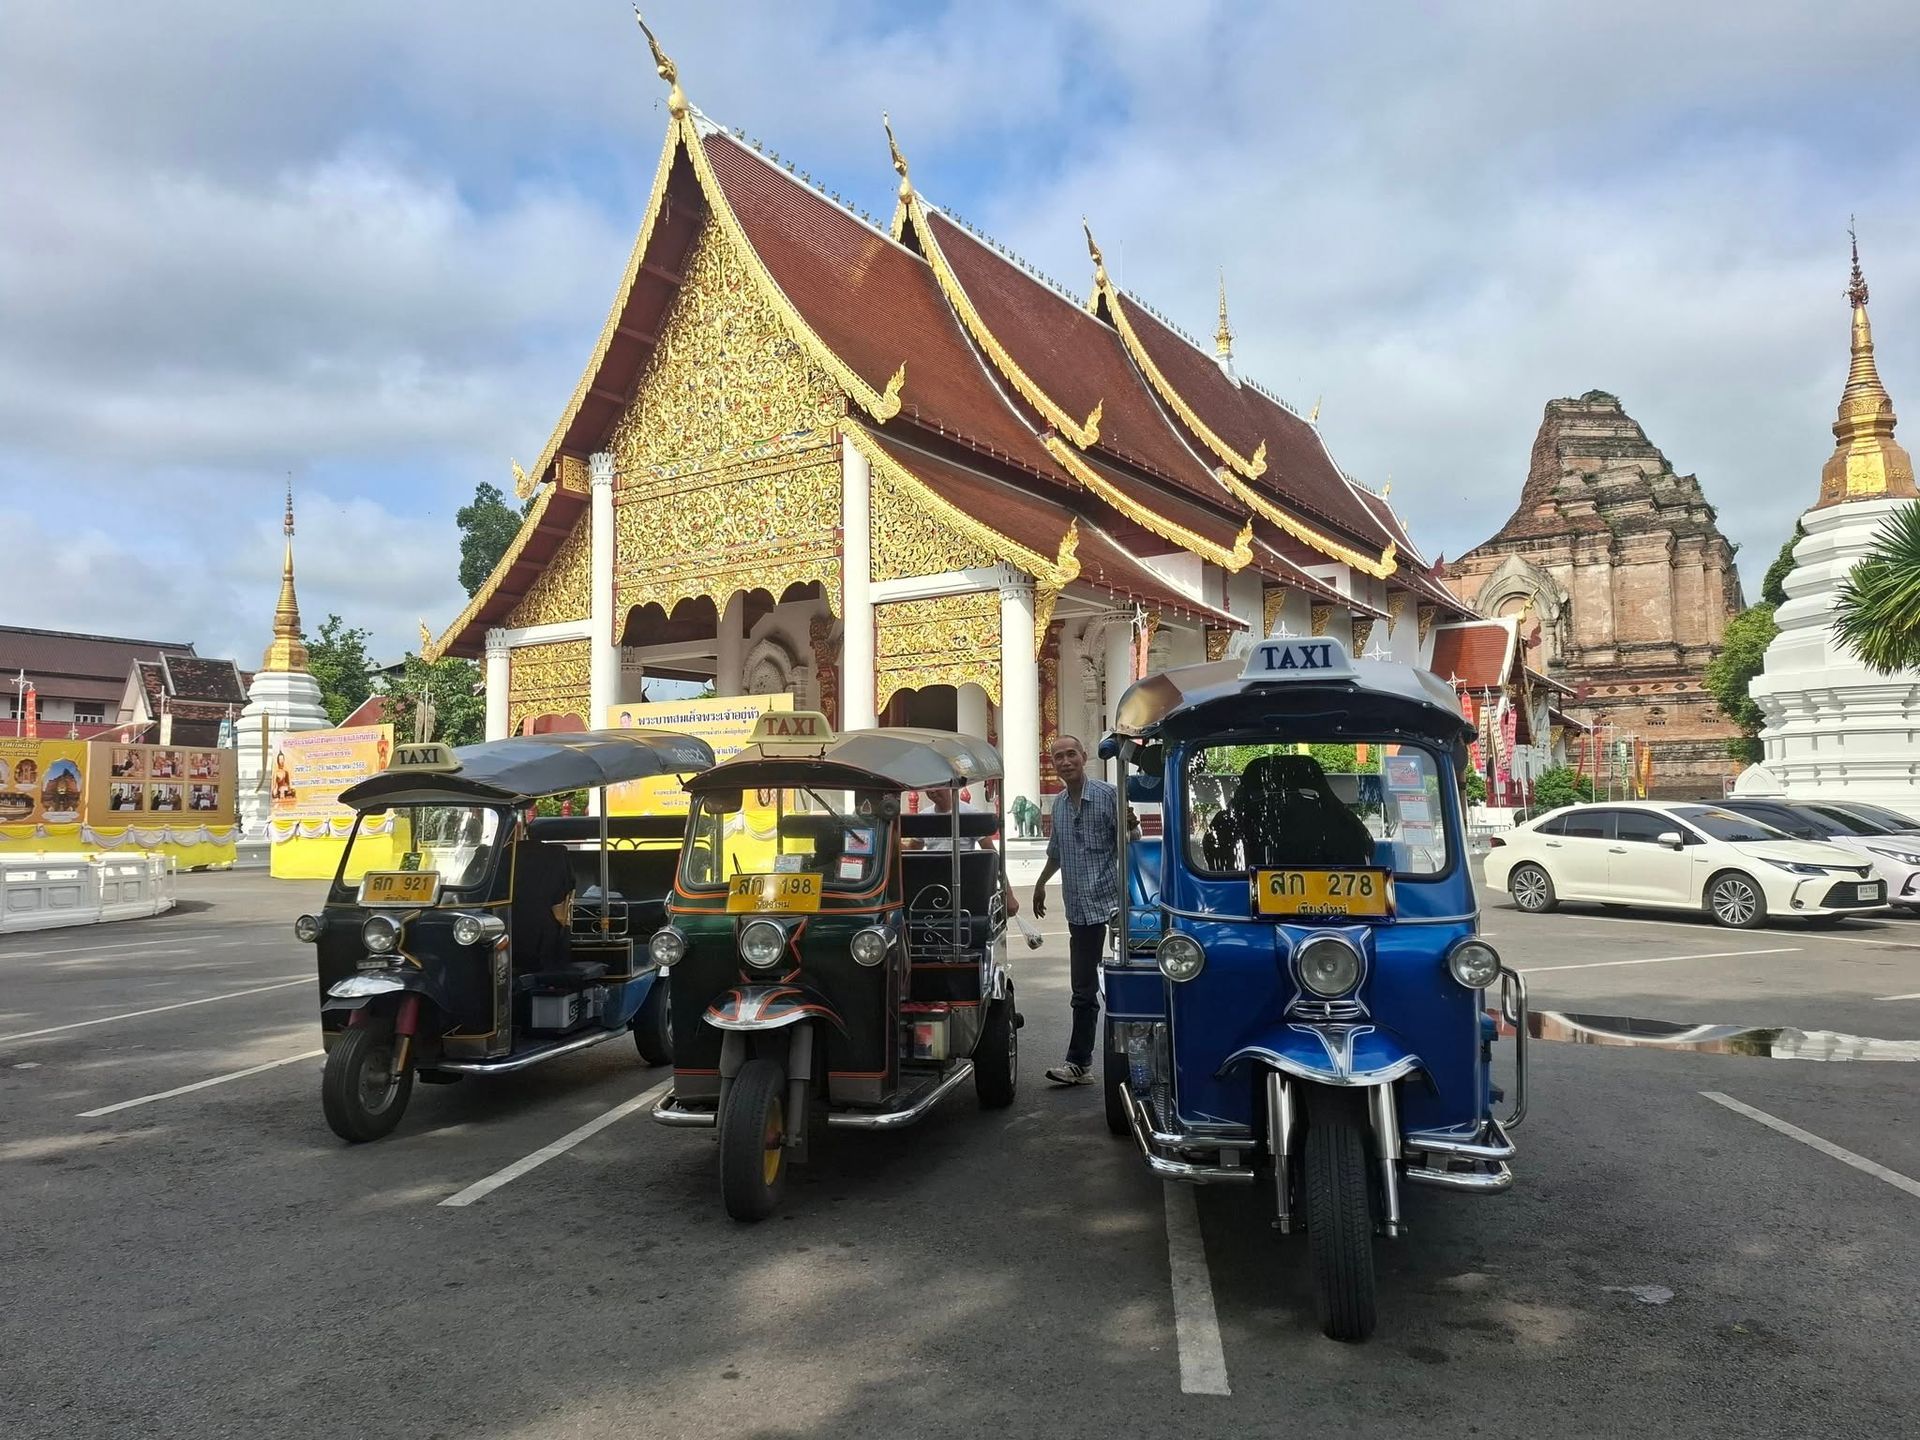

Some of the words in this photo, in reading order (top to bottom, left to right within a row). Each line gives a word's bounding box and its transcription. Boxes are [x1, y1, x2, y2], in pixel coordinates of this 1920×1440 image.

[1259, 644, 1333, 671] TAXI
[637, 706, 760, 726] พระบาทสมเด็จพระเจ้าอยู่หัว
[763, 717, 817, 736] TAXI
[397, 748, 440, 765] TAXI
[373, 876, 394, 891] สก
[403, 876, 428, 891] 921
[738, 876, 766, 896] สก
[782, 877, 812, 895] 198
[1269, 871, 1306, 896] สก
[1326, 873, 1373, 897] 278
[1297, 901, 1347, 914] เชียงใหม่
